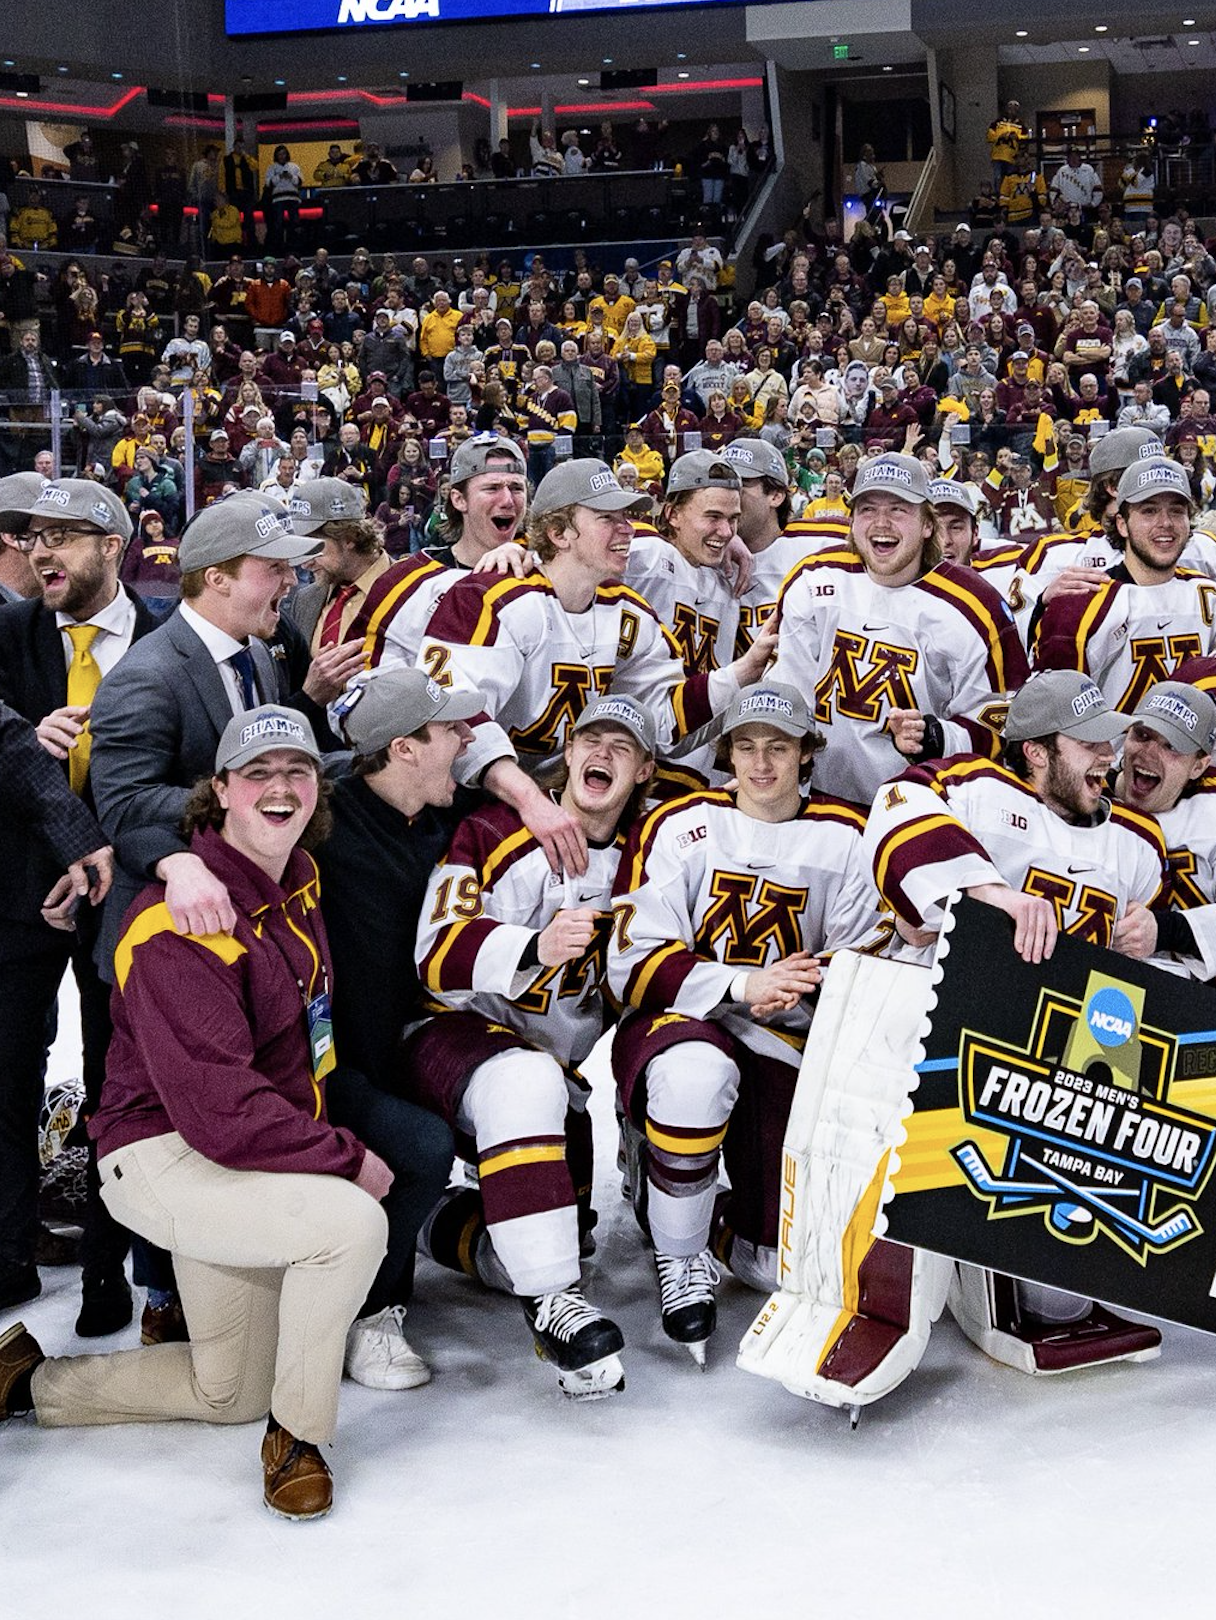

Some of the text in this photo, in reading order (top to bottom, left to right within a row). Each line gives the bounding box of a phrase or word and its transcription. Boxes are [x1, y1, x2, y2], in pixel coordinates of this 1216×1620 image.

[337, 0, 440, 24] NCAA
[833, 45, 849, 59] EXIT
[722, 445, 754, 465] AMPS
[861, 464, 912, 487] CHAMPS
[424, 644, 453, 688] 2
[814, 629, 919, 731] M
[590, 701, 646, 733] CHAMPS
[738, 694, 793, 718] CHAMPS
[1144, 694, 1199, 732] CHAMPS
[240, 717, 306, 747] CHAMPS
[430, 873, 484, 924] 19
[694, 869, 809, 966] M
[1091, 1010, 1133, 1039] NCAA
[1054, 1069, 1140, 1110] 2023 MEN'S
[979, 1065, 1202, 1174] FROZEN FOUR
[1042, 1148, 1124, 1187] TAMPA BAY
[780, 1155, 798, 1282] TRUE
